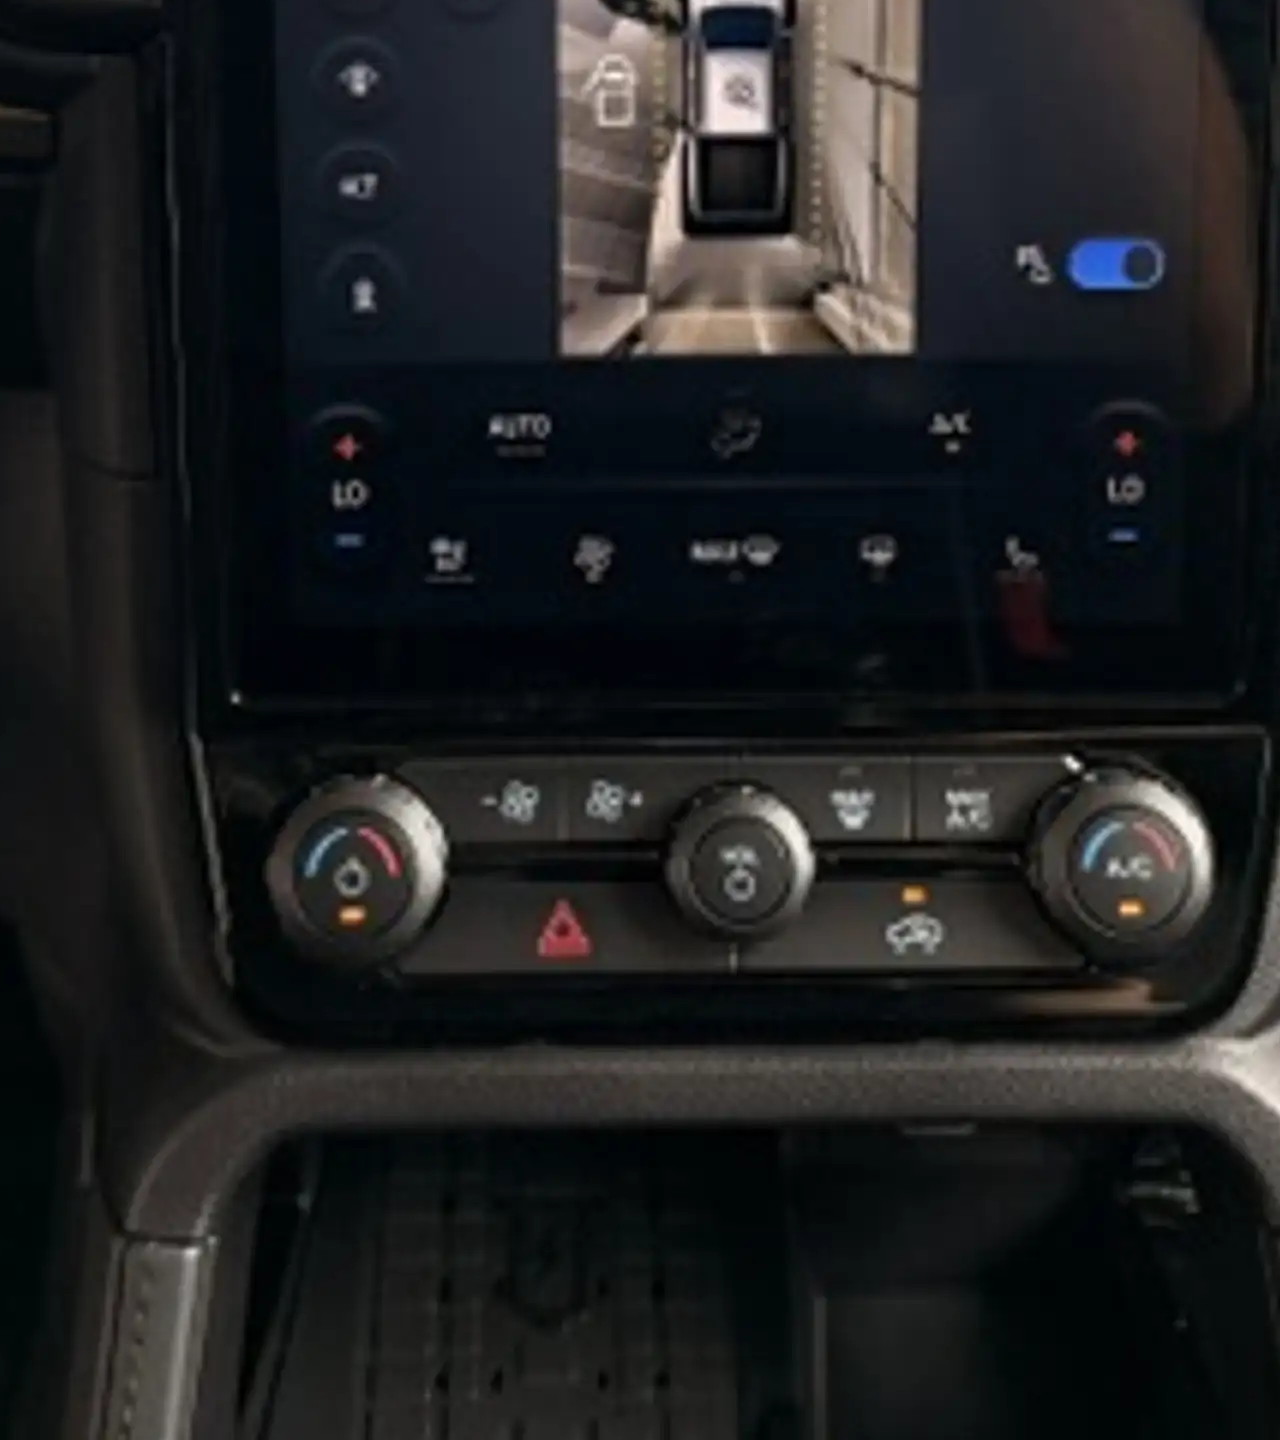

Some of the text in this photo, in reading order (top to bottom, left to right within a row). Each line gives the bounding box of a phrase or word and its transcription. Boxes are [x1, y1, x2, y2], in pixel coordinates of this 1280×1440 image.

[487, 412, 553, 440] AUTO
[331, 479, 369, 510] LO
[1106, 474, 1146, 506] LO
[1105, 856, 1152, 881] A/C
